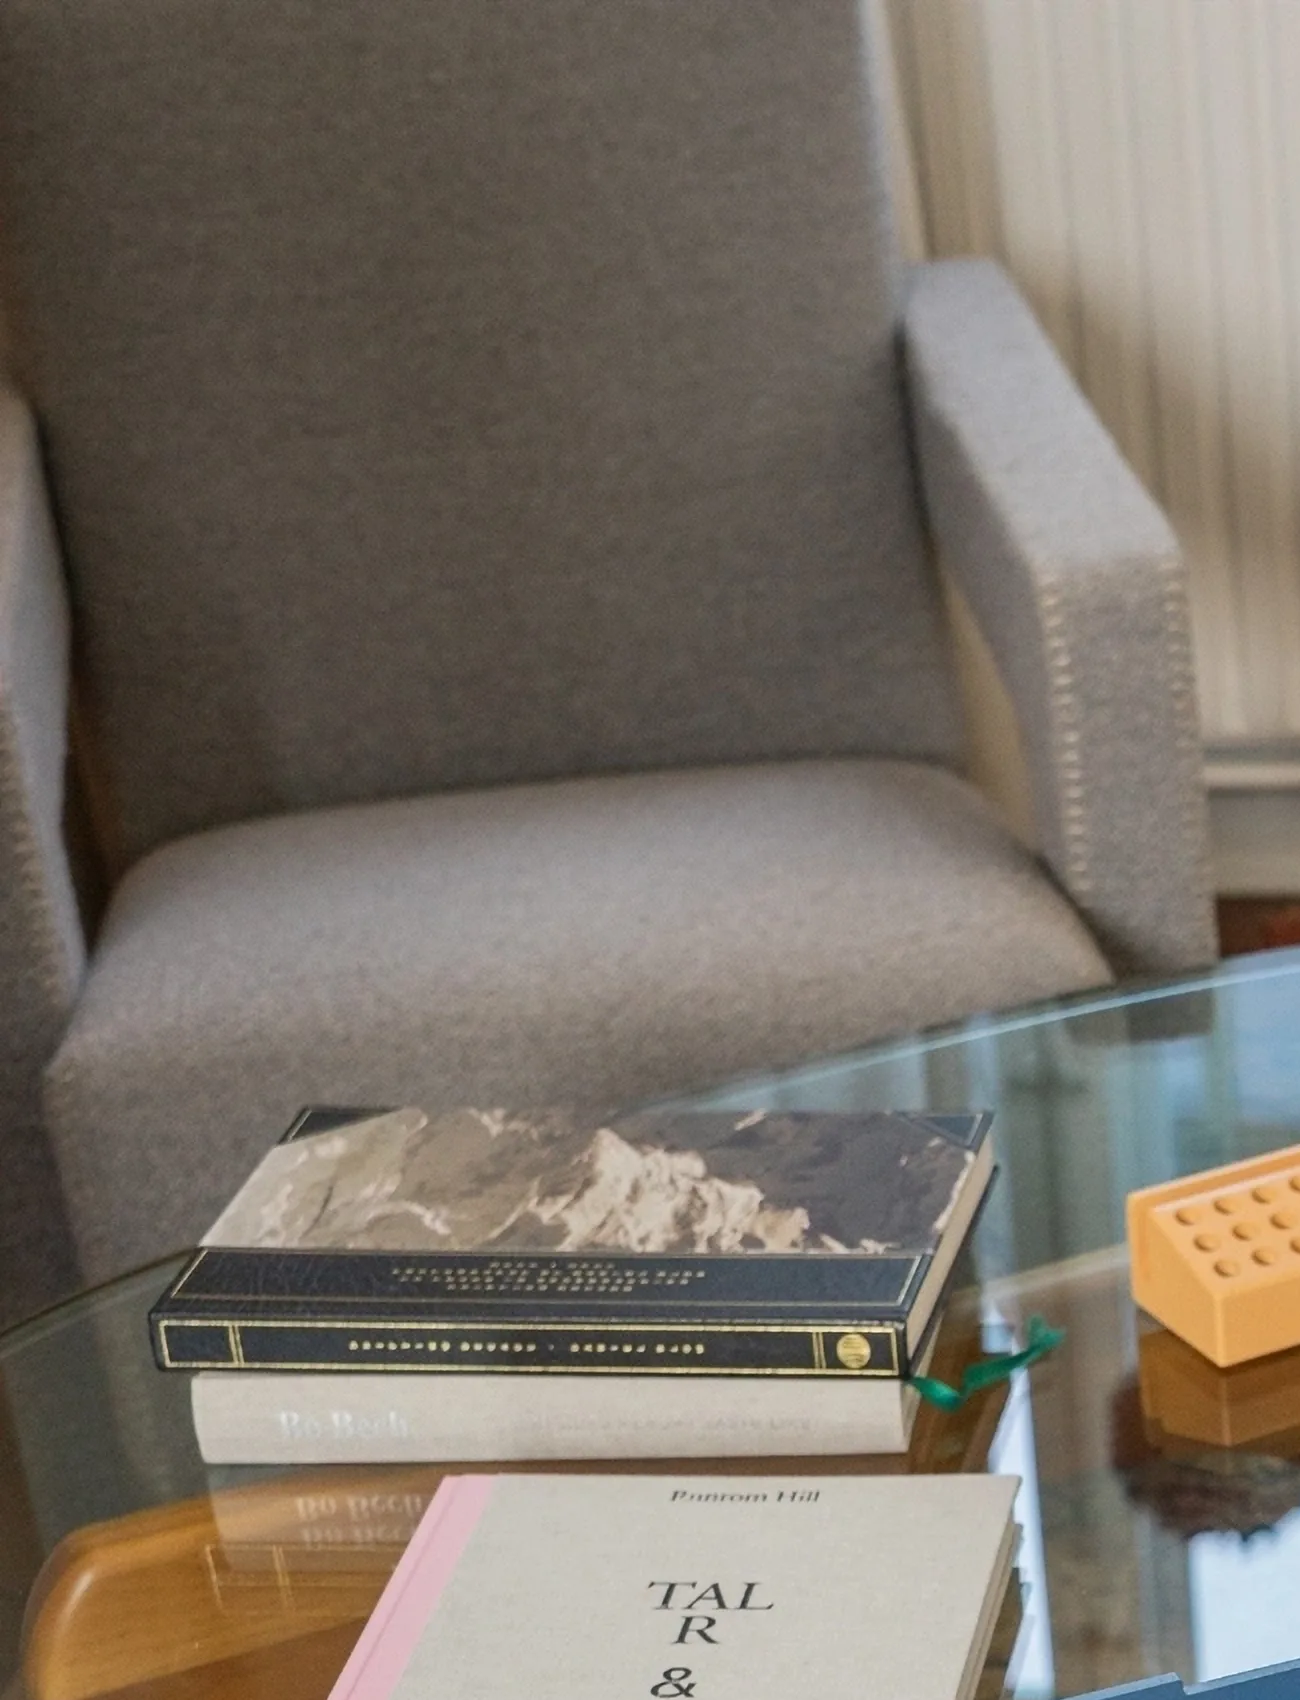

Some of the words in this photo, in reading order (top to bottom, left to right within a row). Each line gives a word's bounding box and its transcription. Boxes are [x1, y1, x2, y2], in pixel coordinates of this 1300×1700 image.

[776, 1489, 821, 1503] Hill
[648, 1581, 774, 1611] TAL
[671, 1616, 720, 1645] R
[650, 1667, 697, 1698] &
